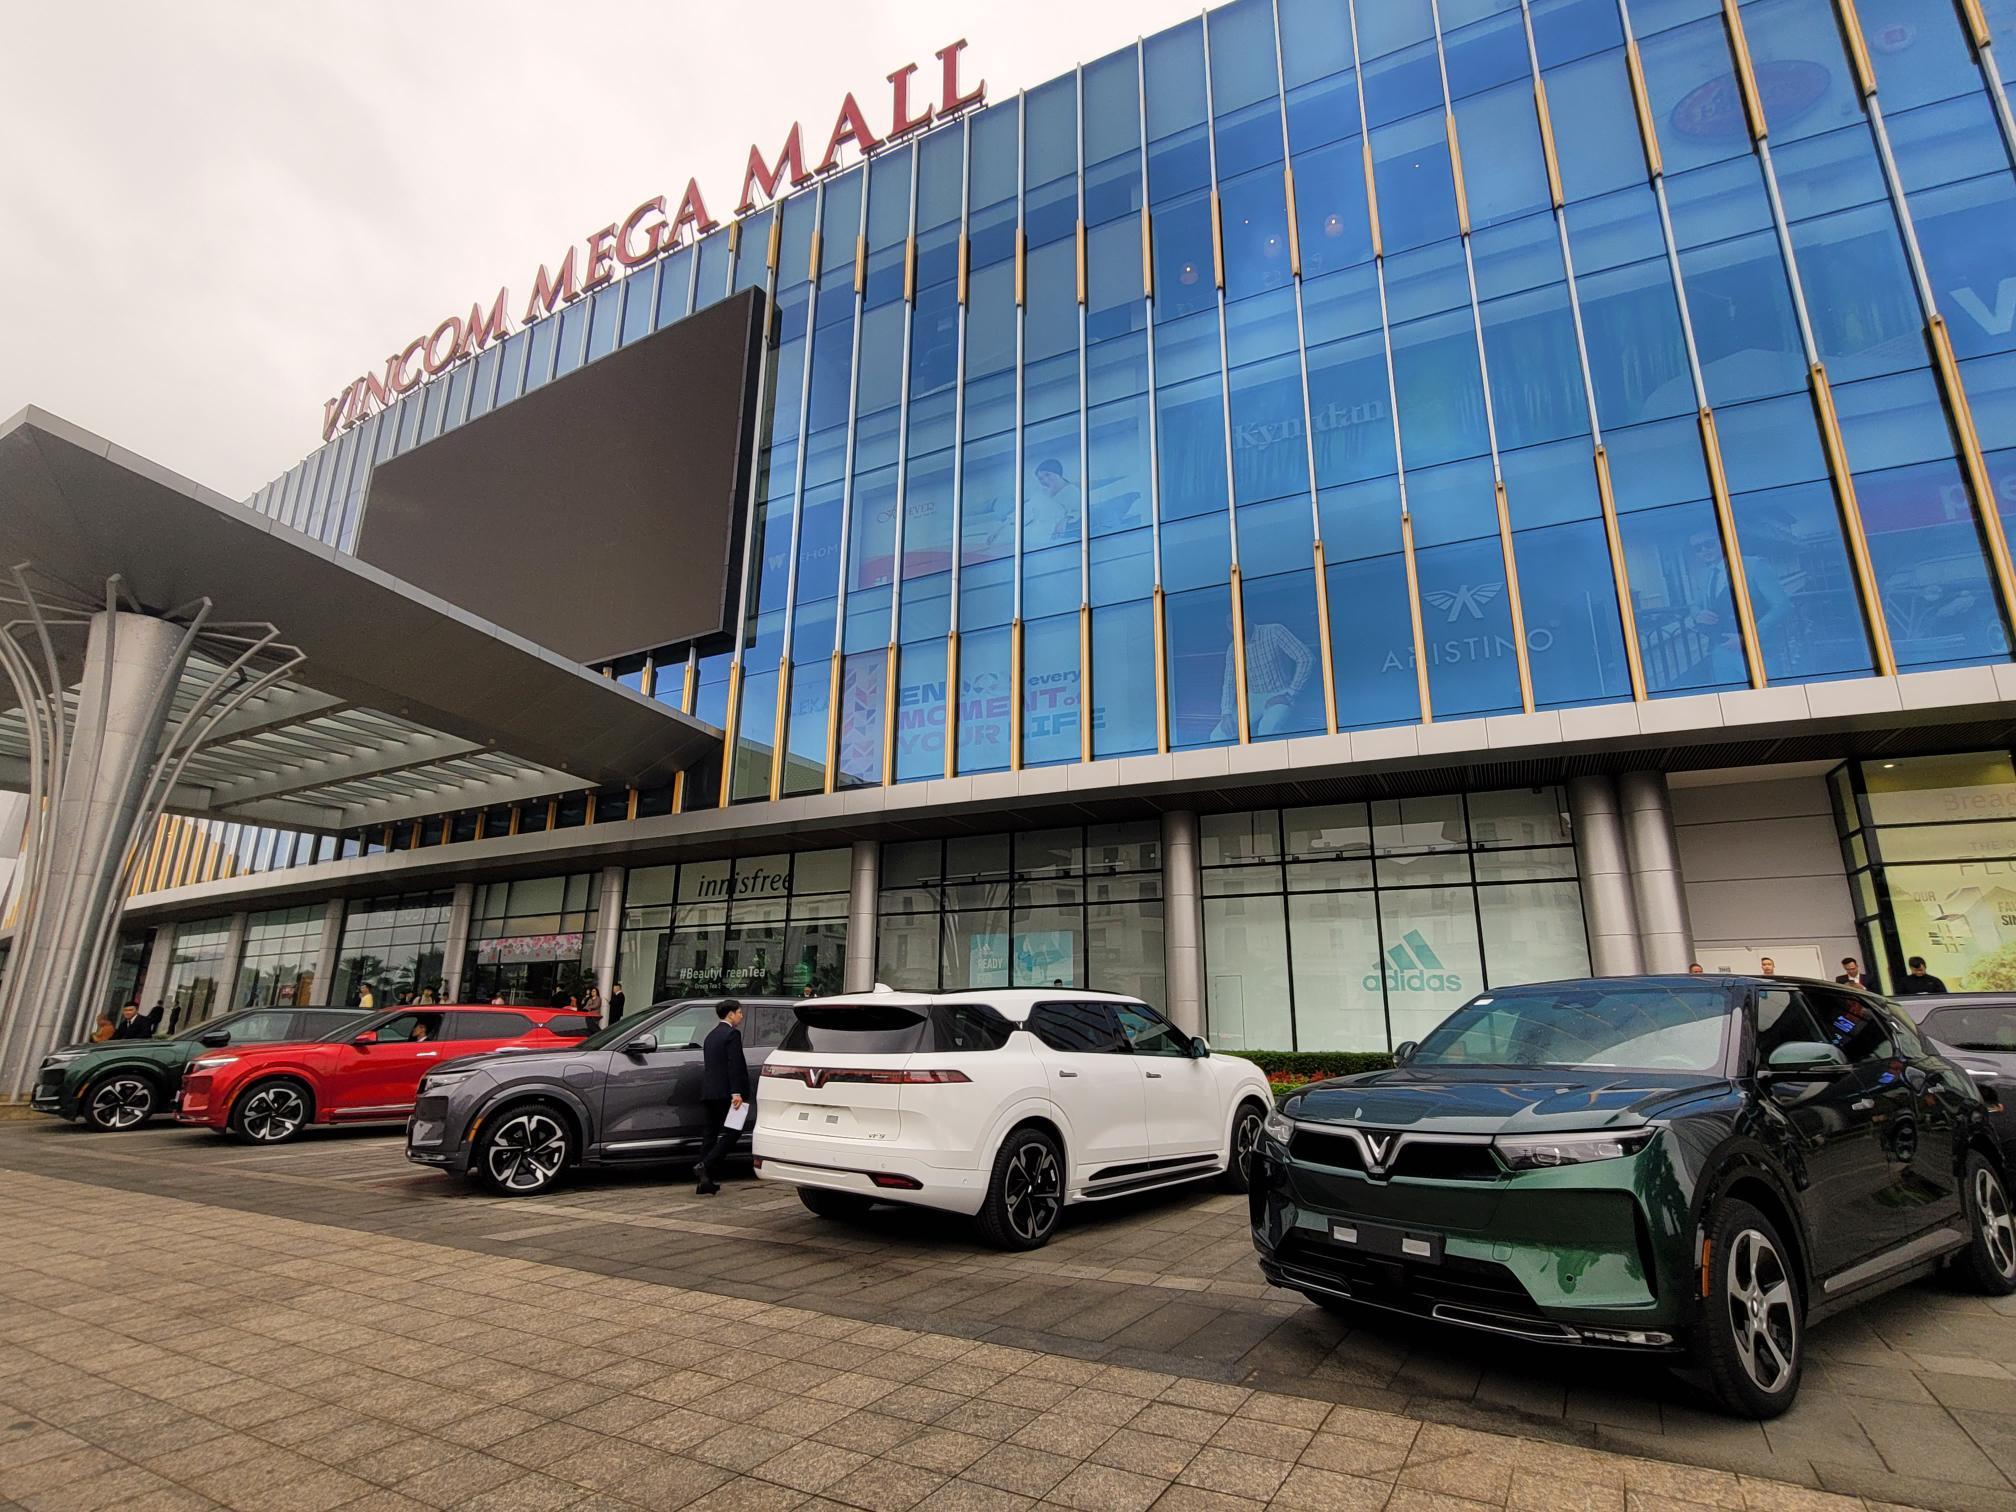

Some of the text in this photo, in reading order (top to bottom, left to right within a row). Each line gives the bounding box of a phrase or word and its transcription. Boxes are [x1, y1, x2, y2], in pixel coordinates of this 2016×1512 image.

[323, 38, 987, 442] VINCOM MEGA MALL
[697, 867, 793, 897] innisfree
[679, 966, 766, 981] #BeautyreenTea
[977, 958, 1003, 969] READY
[1361, 969, 1462, 992] adidas
